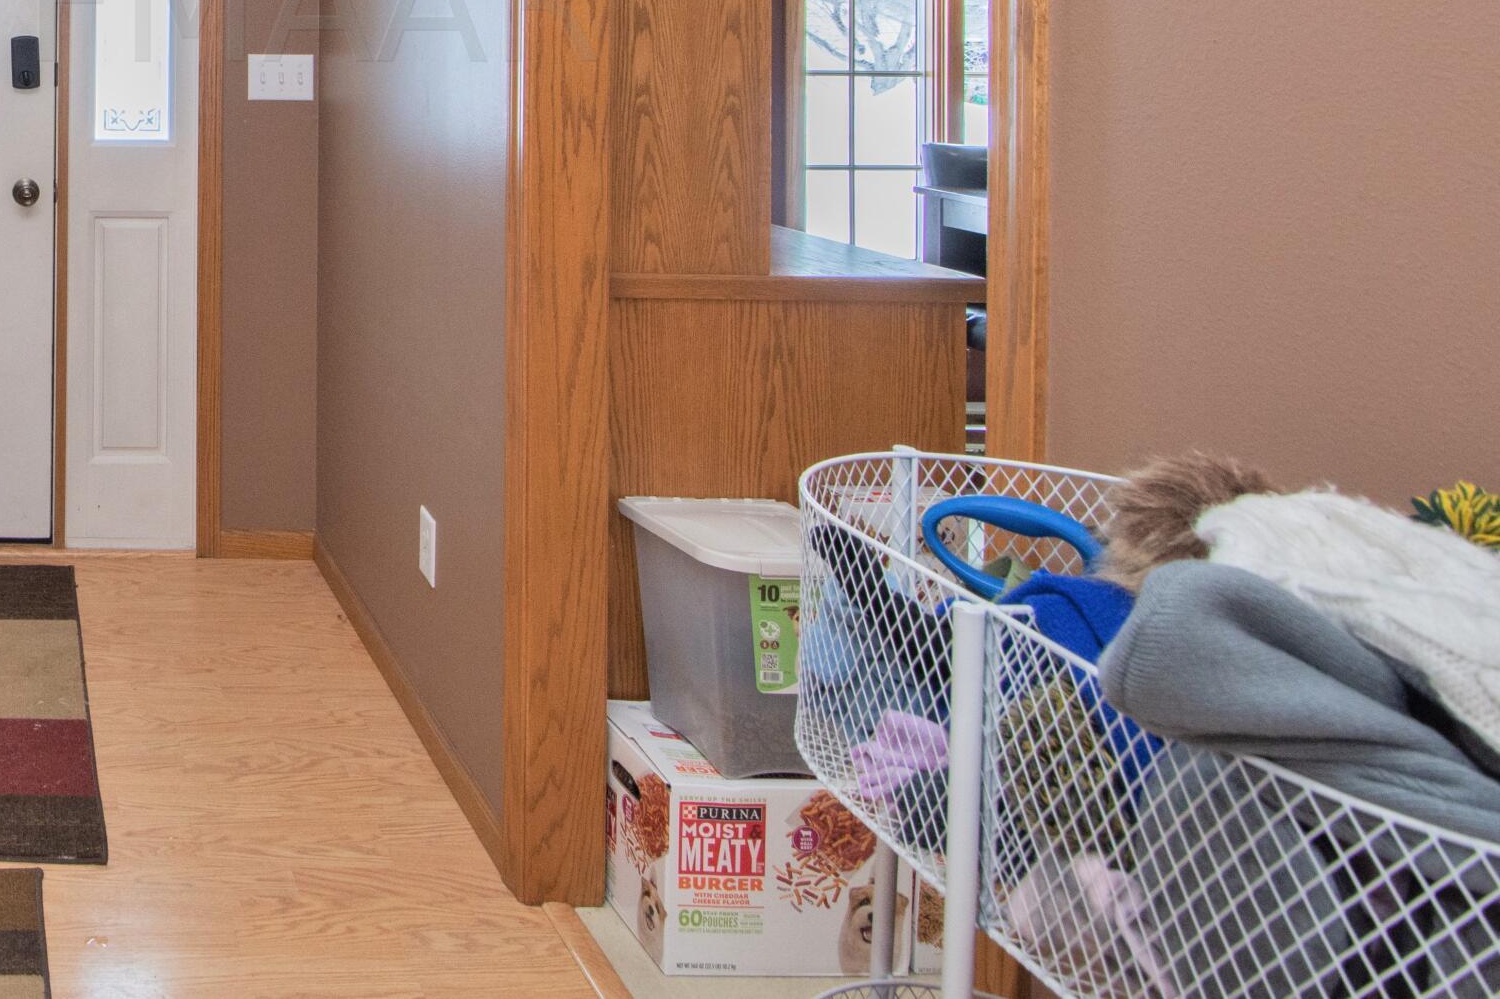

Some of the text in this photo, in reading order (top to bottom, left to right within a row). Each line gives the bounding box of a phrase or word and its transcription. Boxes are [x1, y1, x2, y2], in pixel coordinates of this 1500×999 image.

[757, 584, 780, 603] 10
[699, 807, 760, 819] PURINA
[681, 821, 747, 839] MOIST
[681, 837, 762, 874] MEATY
[678, 876, 764, 891] BURGER
[678, 909, 703, 927] 60
[702, 916, 739, 929] POUCHES
